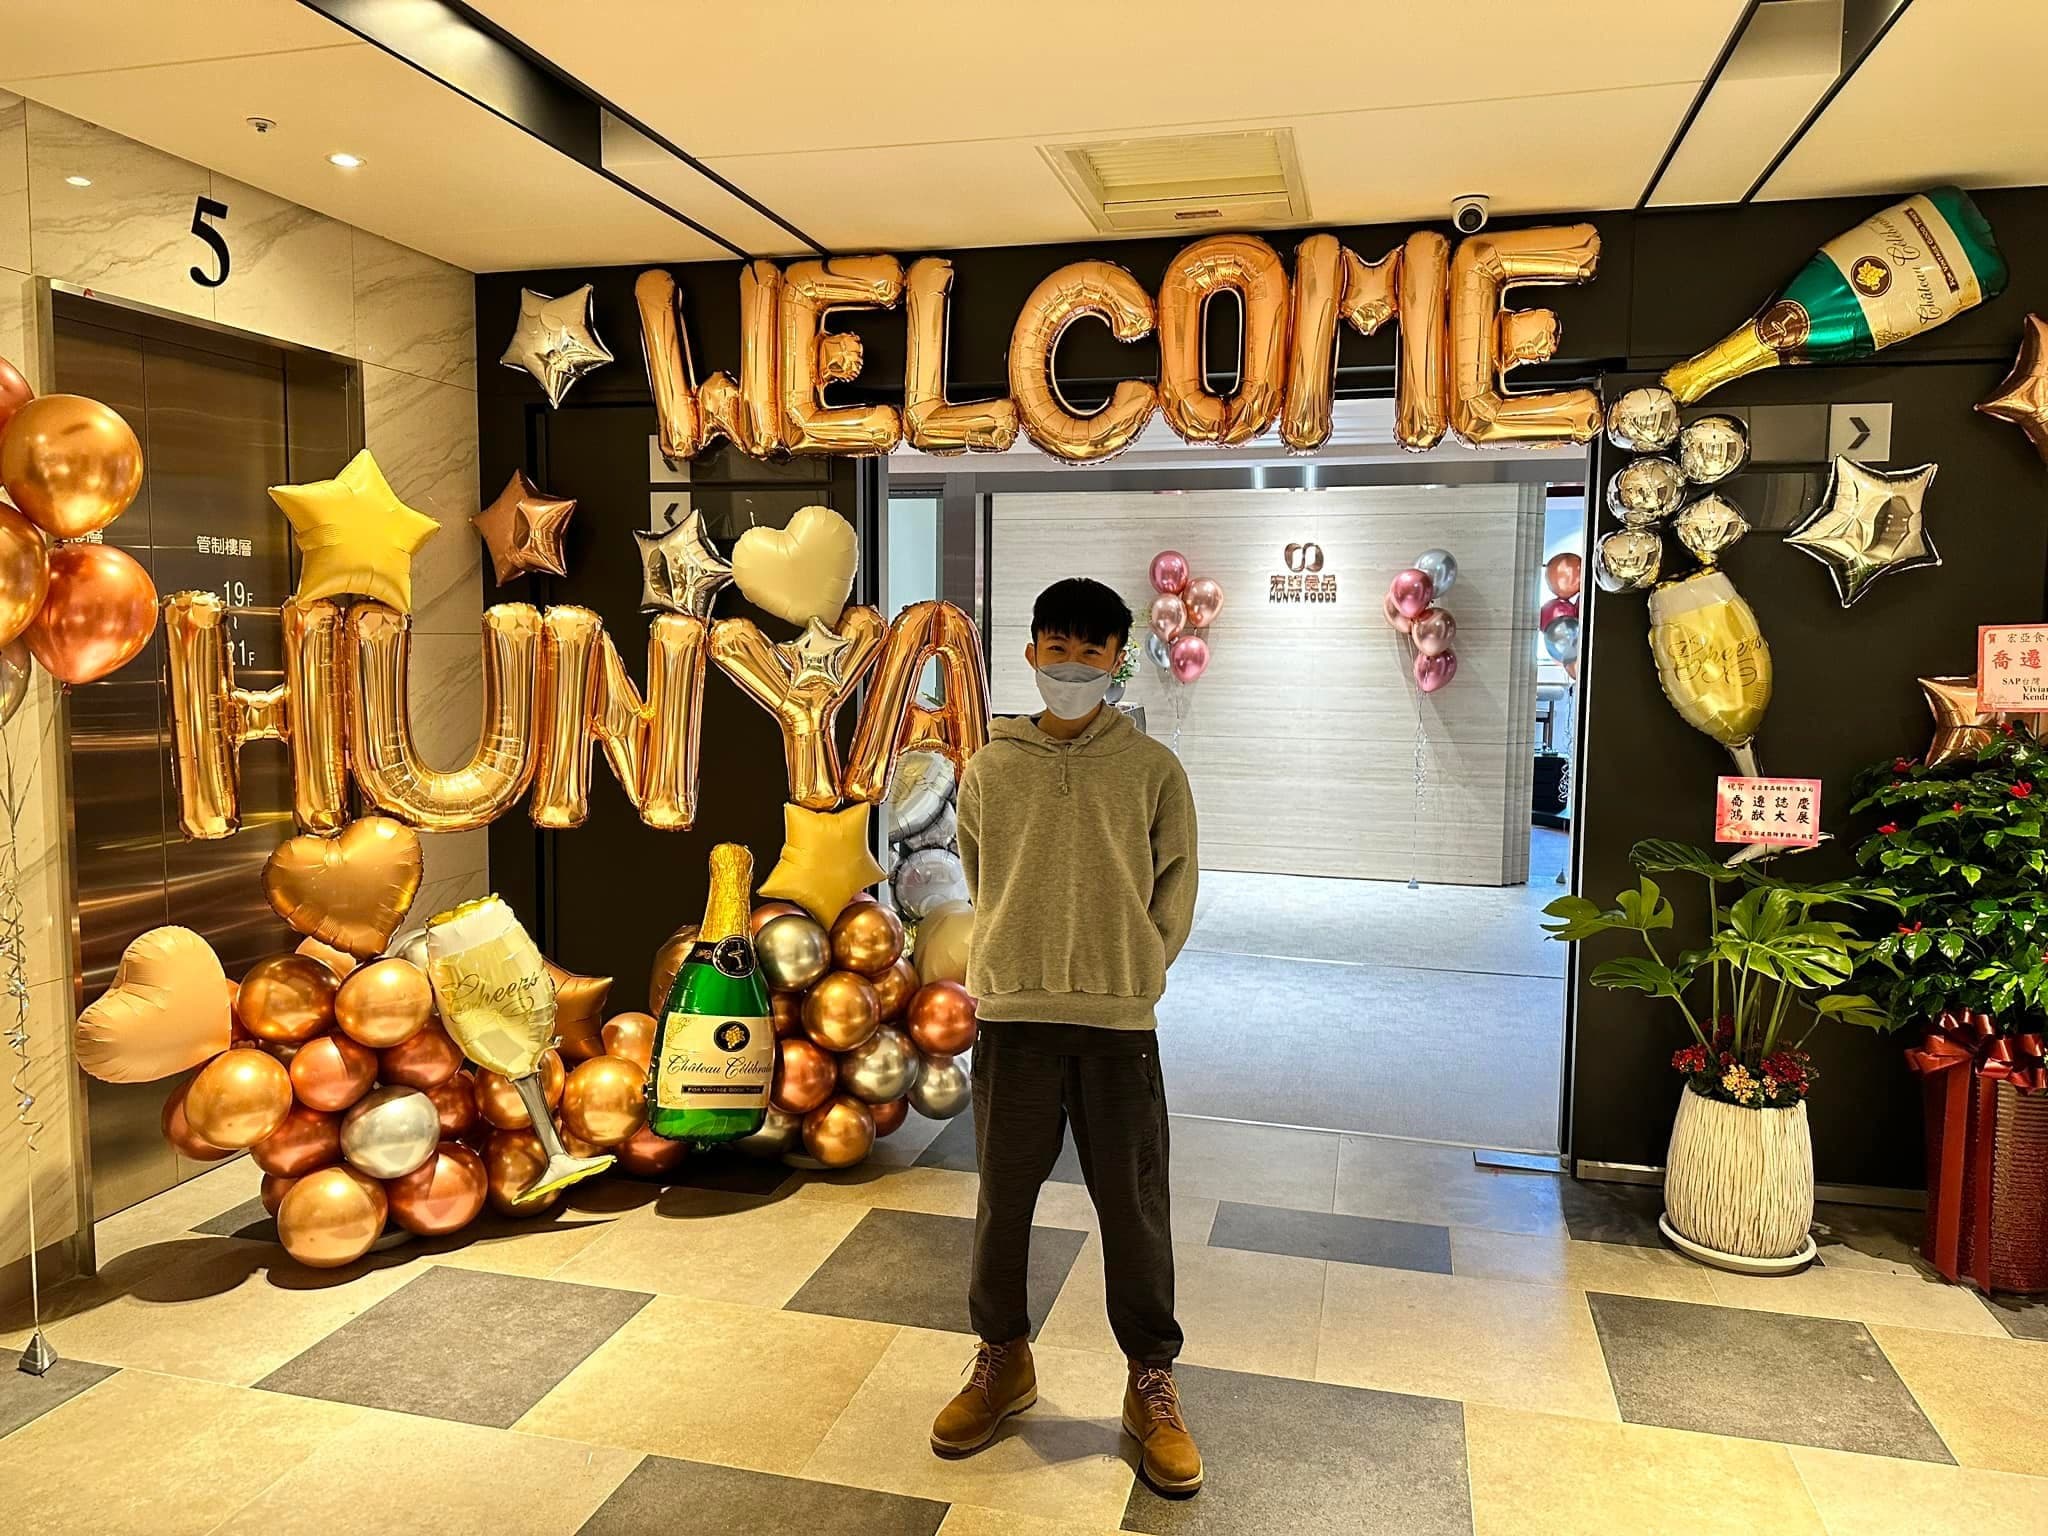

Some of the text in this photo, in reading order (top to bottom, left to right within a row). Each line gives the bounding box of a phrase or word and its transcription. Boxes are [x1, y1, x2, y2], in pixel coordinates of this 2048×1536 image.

[190, 196, 230, 287] 5
[634, 222, 1602, 466] WELCOME
[197, 535, 252, 557] 管制樓層
[224, 580, 253, 608] 19F
[1269, 592, 1337, 603] HUNYA FOODS
[2007, 631, 2048, 644] 宏亞食
[1991, 649, 2042, 670] 喬遷
[162, 589, 992, 842] HUNYA
[440, 971, 540, 1024] Cheers
